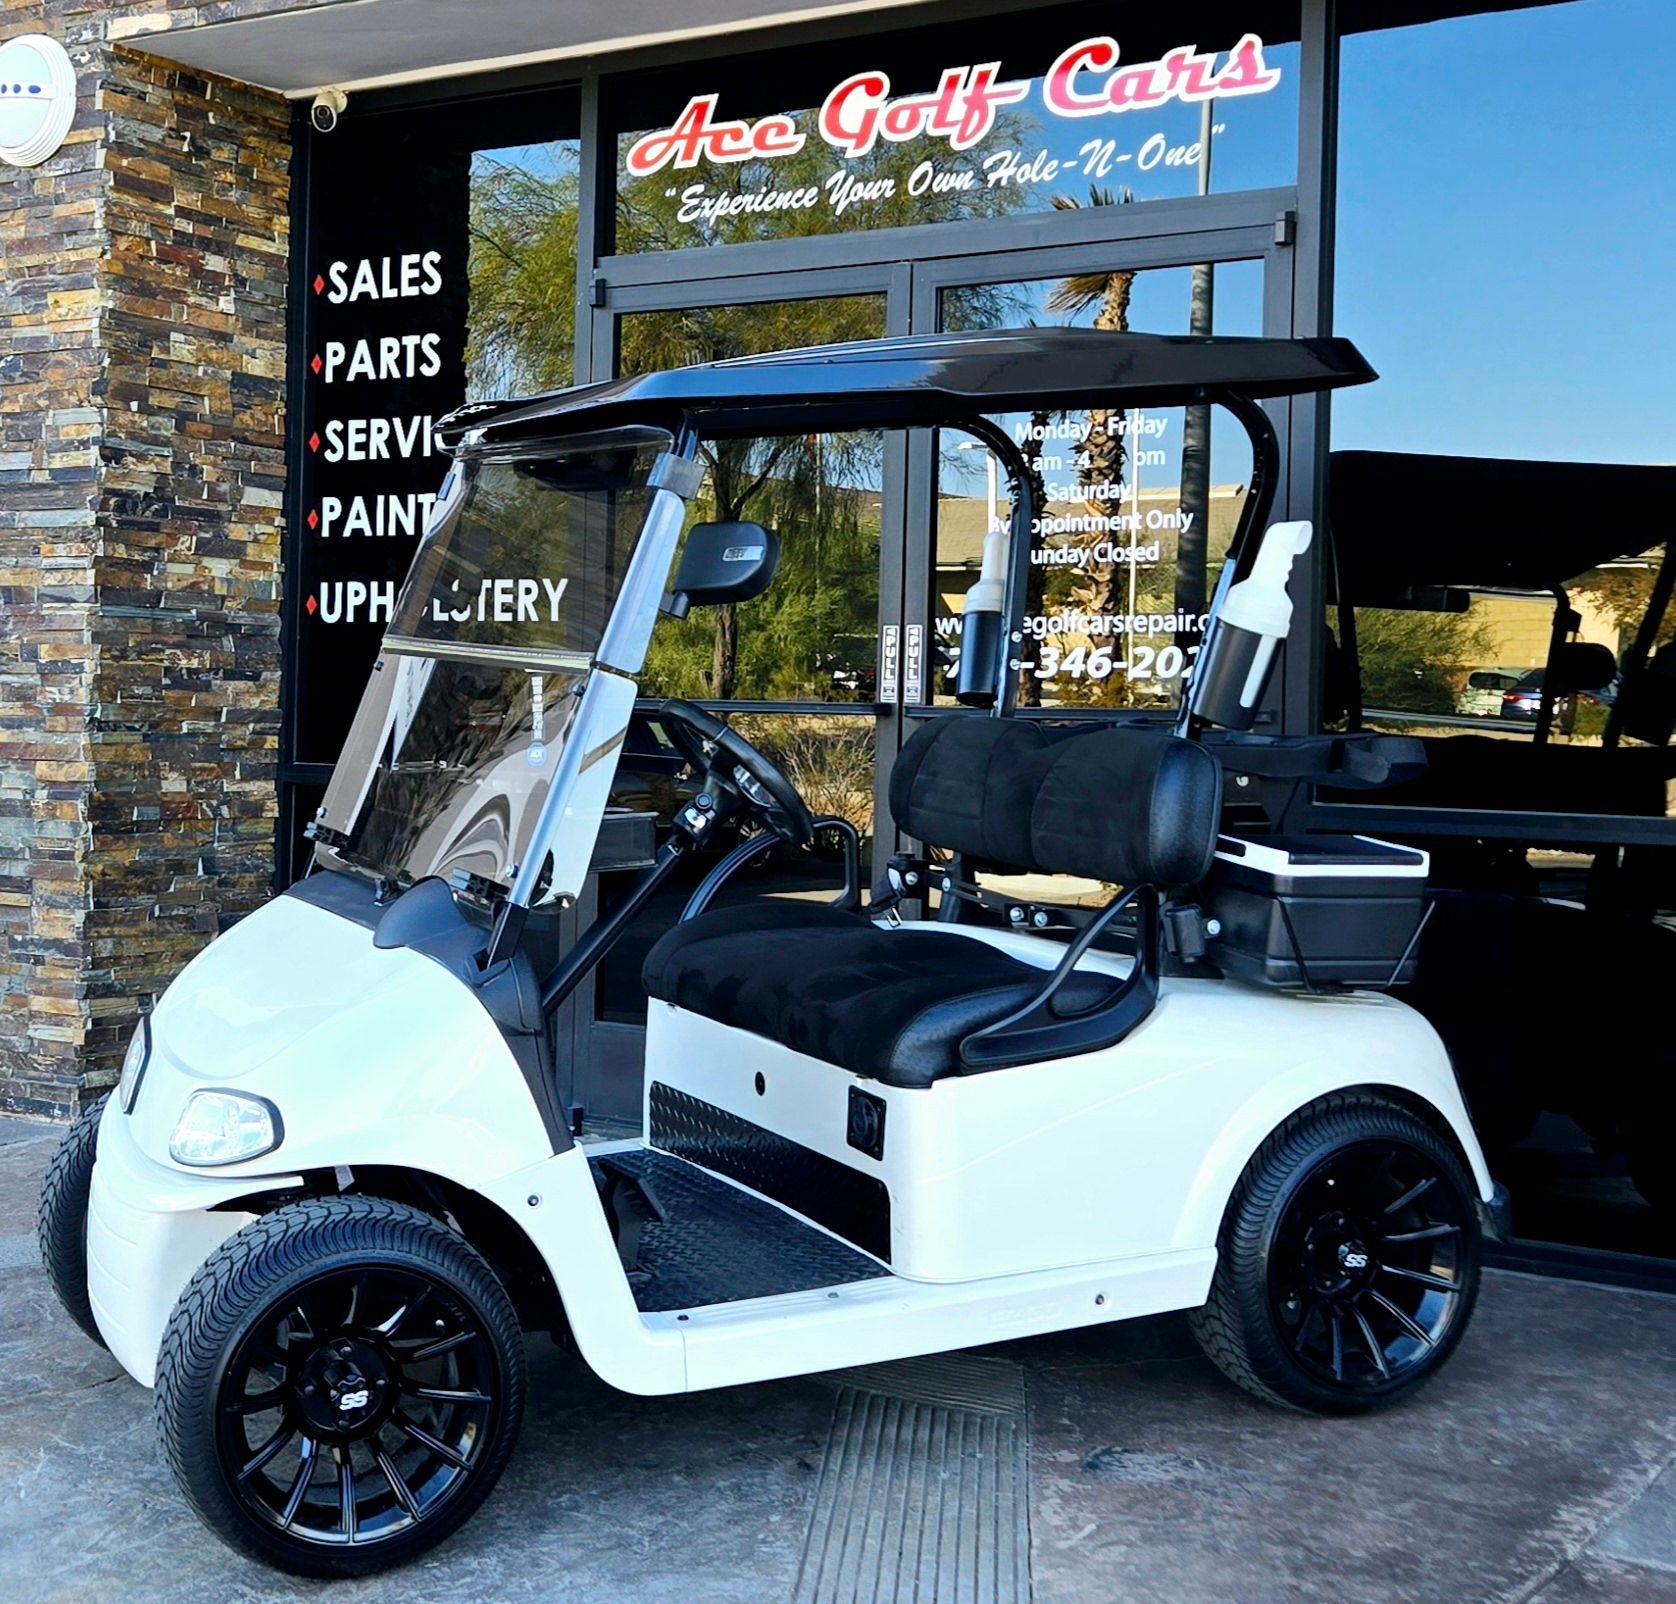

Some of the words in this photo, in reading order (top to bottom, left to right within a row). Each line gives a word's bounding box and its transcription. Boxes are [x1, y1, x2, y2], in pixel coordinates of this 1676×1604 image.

[626, 93, 806, 176] Ace
[818, 61, 1031, 159] Golf
[1043, 33, 1281, 117] Cars
[825, 170, 896, 216] Your
[908, 161, 974, 196] Own
[327, 251, 442, 303] SALES
[324, 333, 441, 383] PARTS
[324, 415, 446, 463] SERVI
[1015, 417, 1092, 443] Monday
[1107, 415, 1168, 438] Friday
[1032, 454, 1062, 472] am
[1046, 479, 1132, 505] Saturday
[320, 493, 436, 538] PAINT
[1146, 508, 1194, 532] Only
[1030, 541, 1091, 568] unday
[1094, 540, 1160, 563] Closed
[885, 635, 897, 680] PULL
[908, 635, 919, 680] PULL
[1344, 1253, 1369, 1268] SS
[339, 1389, 369, 1411] SS
